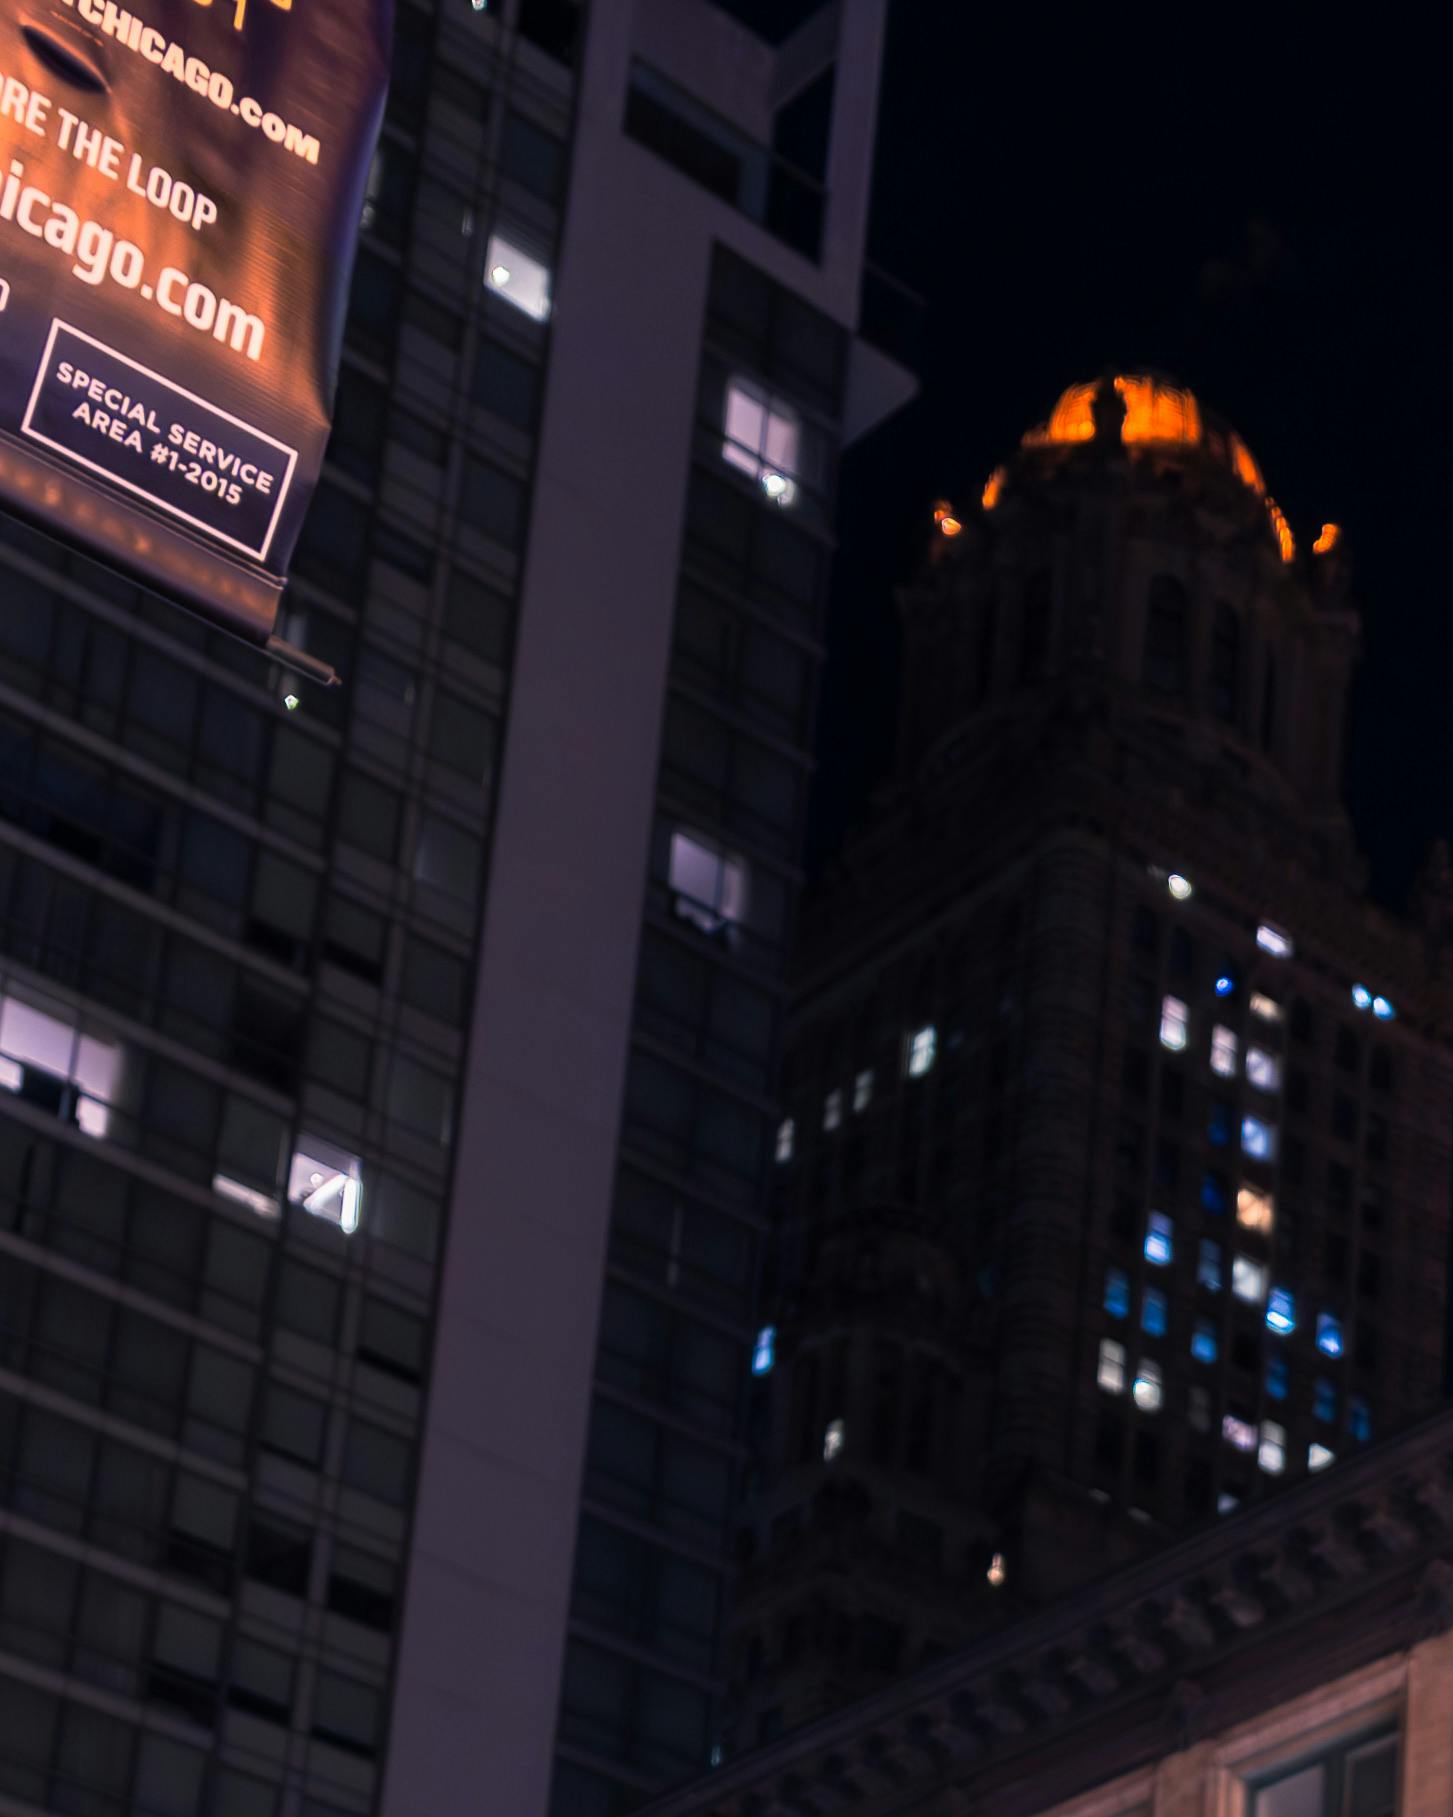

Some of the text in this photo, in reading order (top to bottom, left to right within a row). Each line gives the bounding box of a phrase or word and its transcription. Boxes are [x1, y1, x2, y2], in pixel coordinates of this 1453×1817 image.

[62, 0, 321, 165] CHICAGO.COM
[57, 107, 125, 181] THE
[126, 152, 218, 231] LOOP
[0, 159, 265, 361] icago.com
[56, 361, 275, 495] SPECIAL SERVICE
[72, 401, 243, 506] AREA #1-2015
